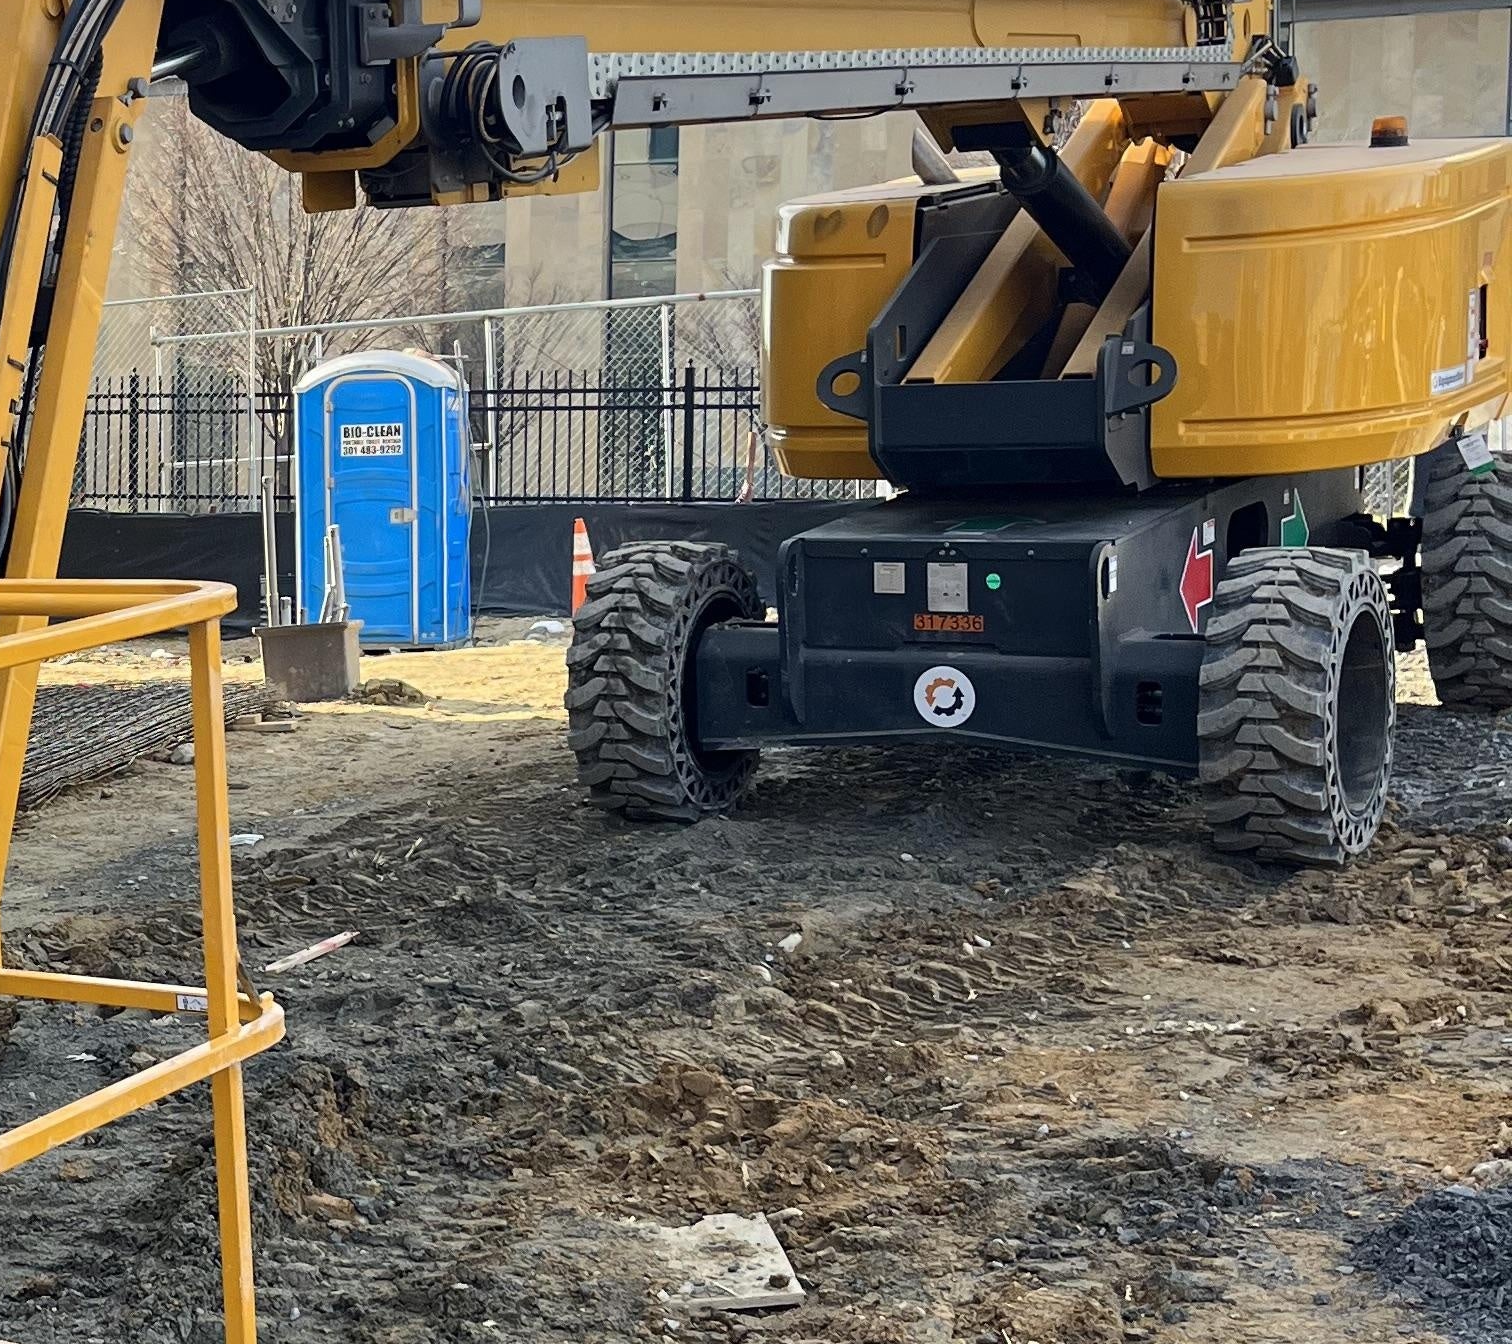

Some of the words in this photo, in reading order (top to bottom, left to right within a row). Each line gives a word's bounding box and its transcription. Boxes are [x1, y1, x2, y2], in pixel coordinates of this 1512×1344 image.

[343, 425, 401, 438] BIO-CLEAN
[343, 446, 357, 455] 301
[915, 615, 983, 630] 317336
